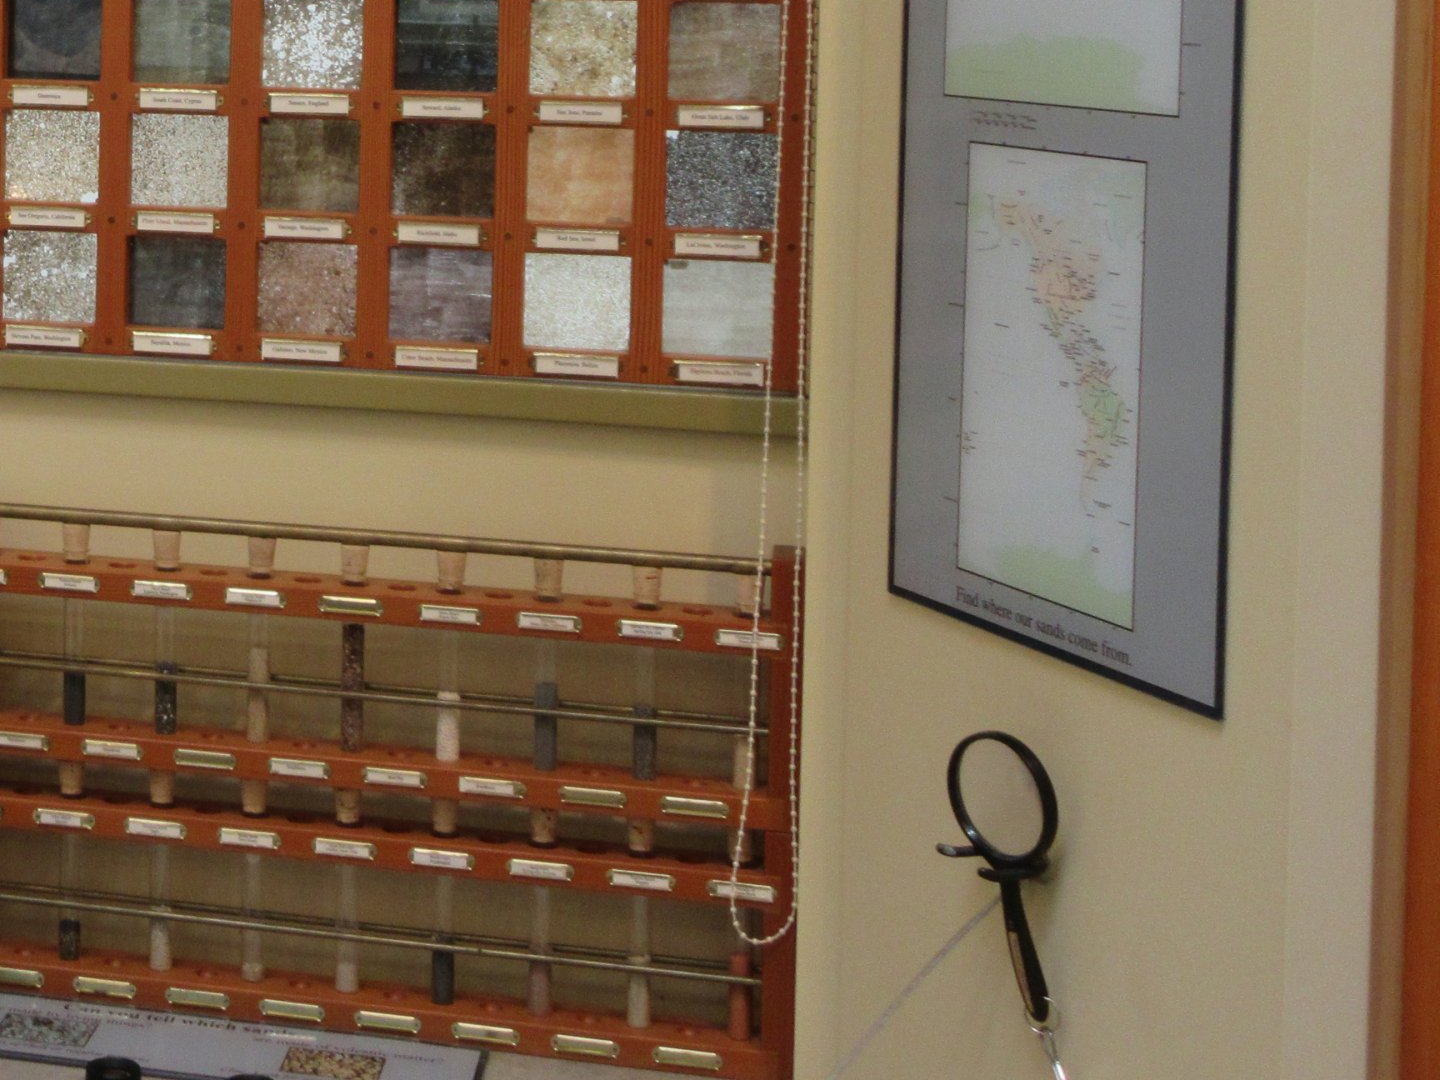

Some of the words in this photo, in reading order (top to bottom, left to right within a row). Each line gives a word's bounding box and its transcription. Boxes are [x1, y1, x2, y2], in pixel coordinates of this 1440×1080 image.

[956, 586, 978, 607] Find
[982, 597, 1011, 620] where
[1015, 612, 1032, 625] our
[1035, 620, 1065, 640] sands
[1068, 633, 1098, 651] come
[1102, 640, 1131, 666] from.
